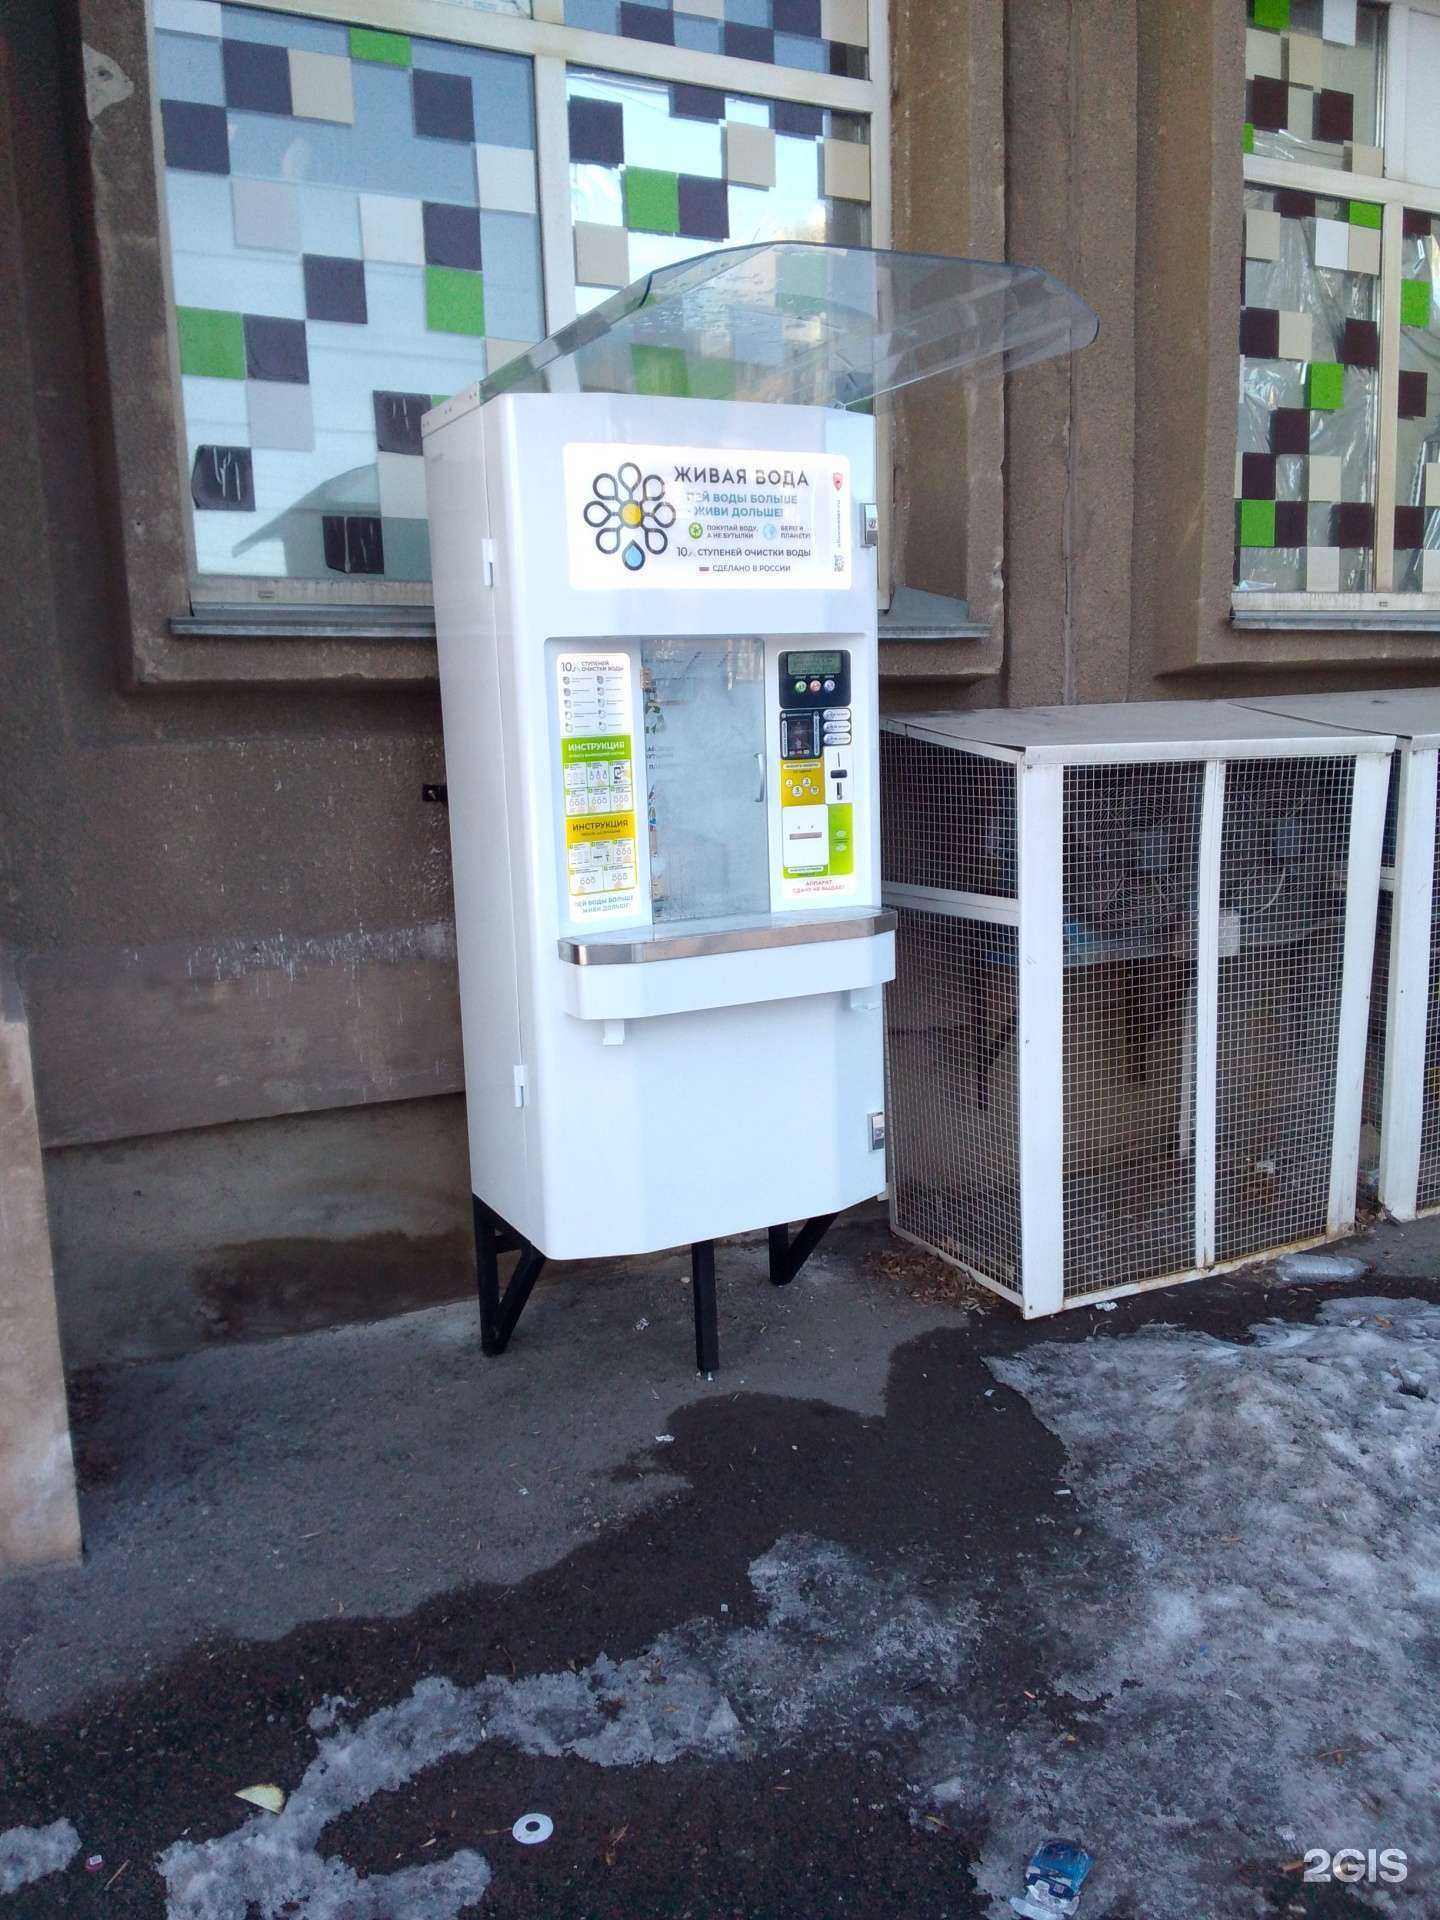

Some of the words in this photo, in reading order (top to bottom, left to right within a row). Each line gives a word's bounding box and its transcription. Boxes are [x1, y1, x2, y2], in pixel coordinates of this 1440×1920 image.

[674, 466, 747, 485] ЖИВАЯ
[755, 469, 809, 488] ВОДА
[713, 493, 747, 504] ВОДЫ
[750, 494, 798, 504] БОЛЬШЕ
[694, 506, 729, 517] ЖИВИ
[732, 507, 784, 518] ДОЛЬШЕ!
[706, 524, 738, 532] ПОКУПАЙ
[676, 546, 688, 557] 10
[697, 547, 742, 557] СТУПЕНЕЙ
[744, 549, 785, 557] ОЧИСТКИ
[786, 549, 811, 558] ВОДЫ
[712, 565, 750, 573] СДЕЛАНО
[561, 662, 572, 672] 10
[568, 741, 625, 752] ИНСТРУКЦИЯ
[572, 819, 629, 831] ИНСТРУКЦИЯ
